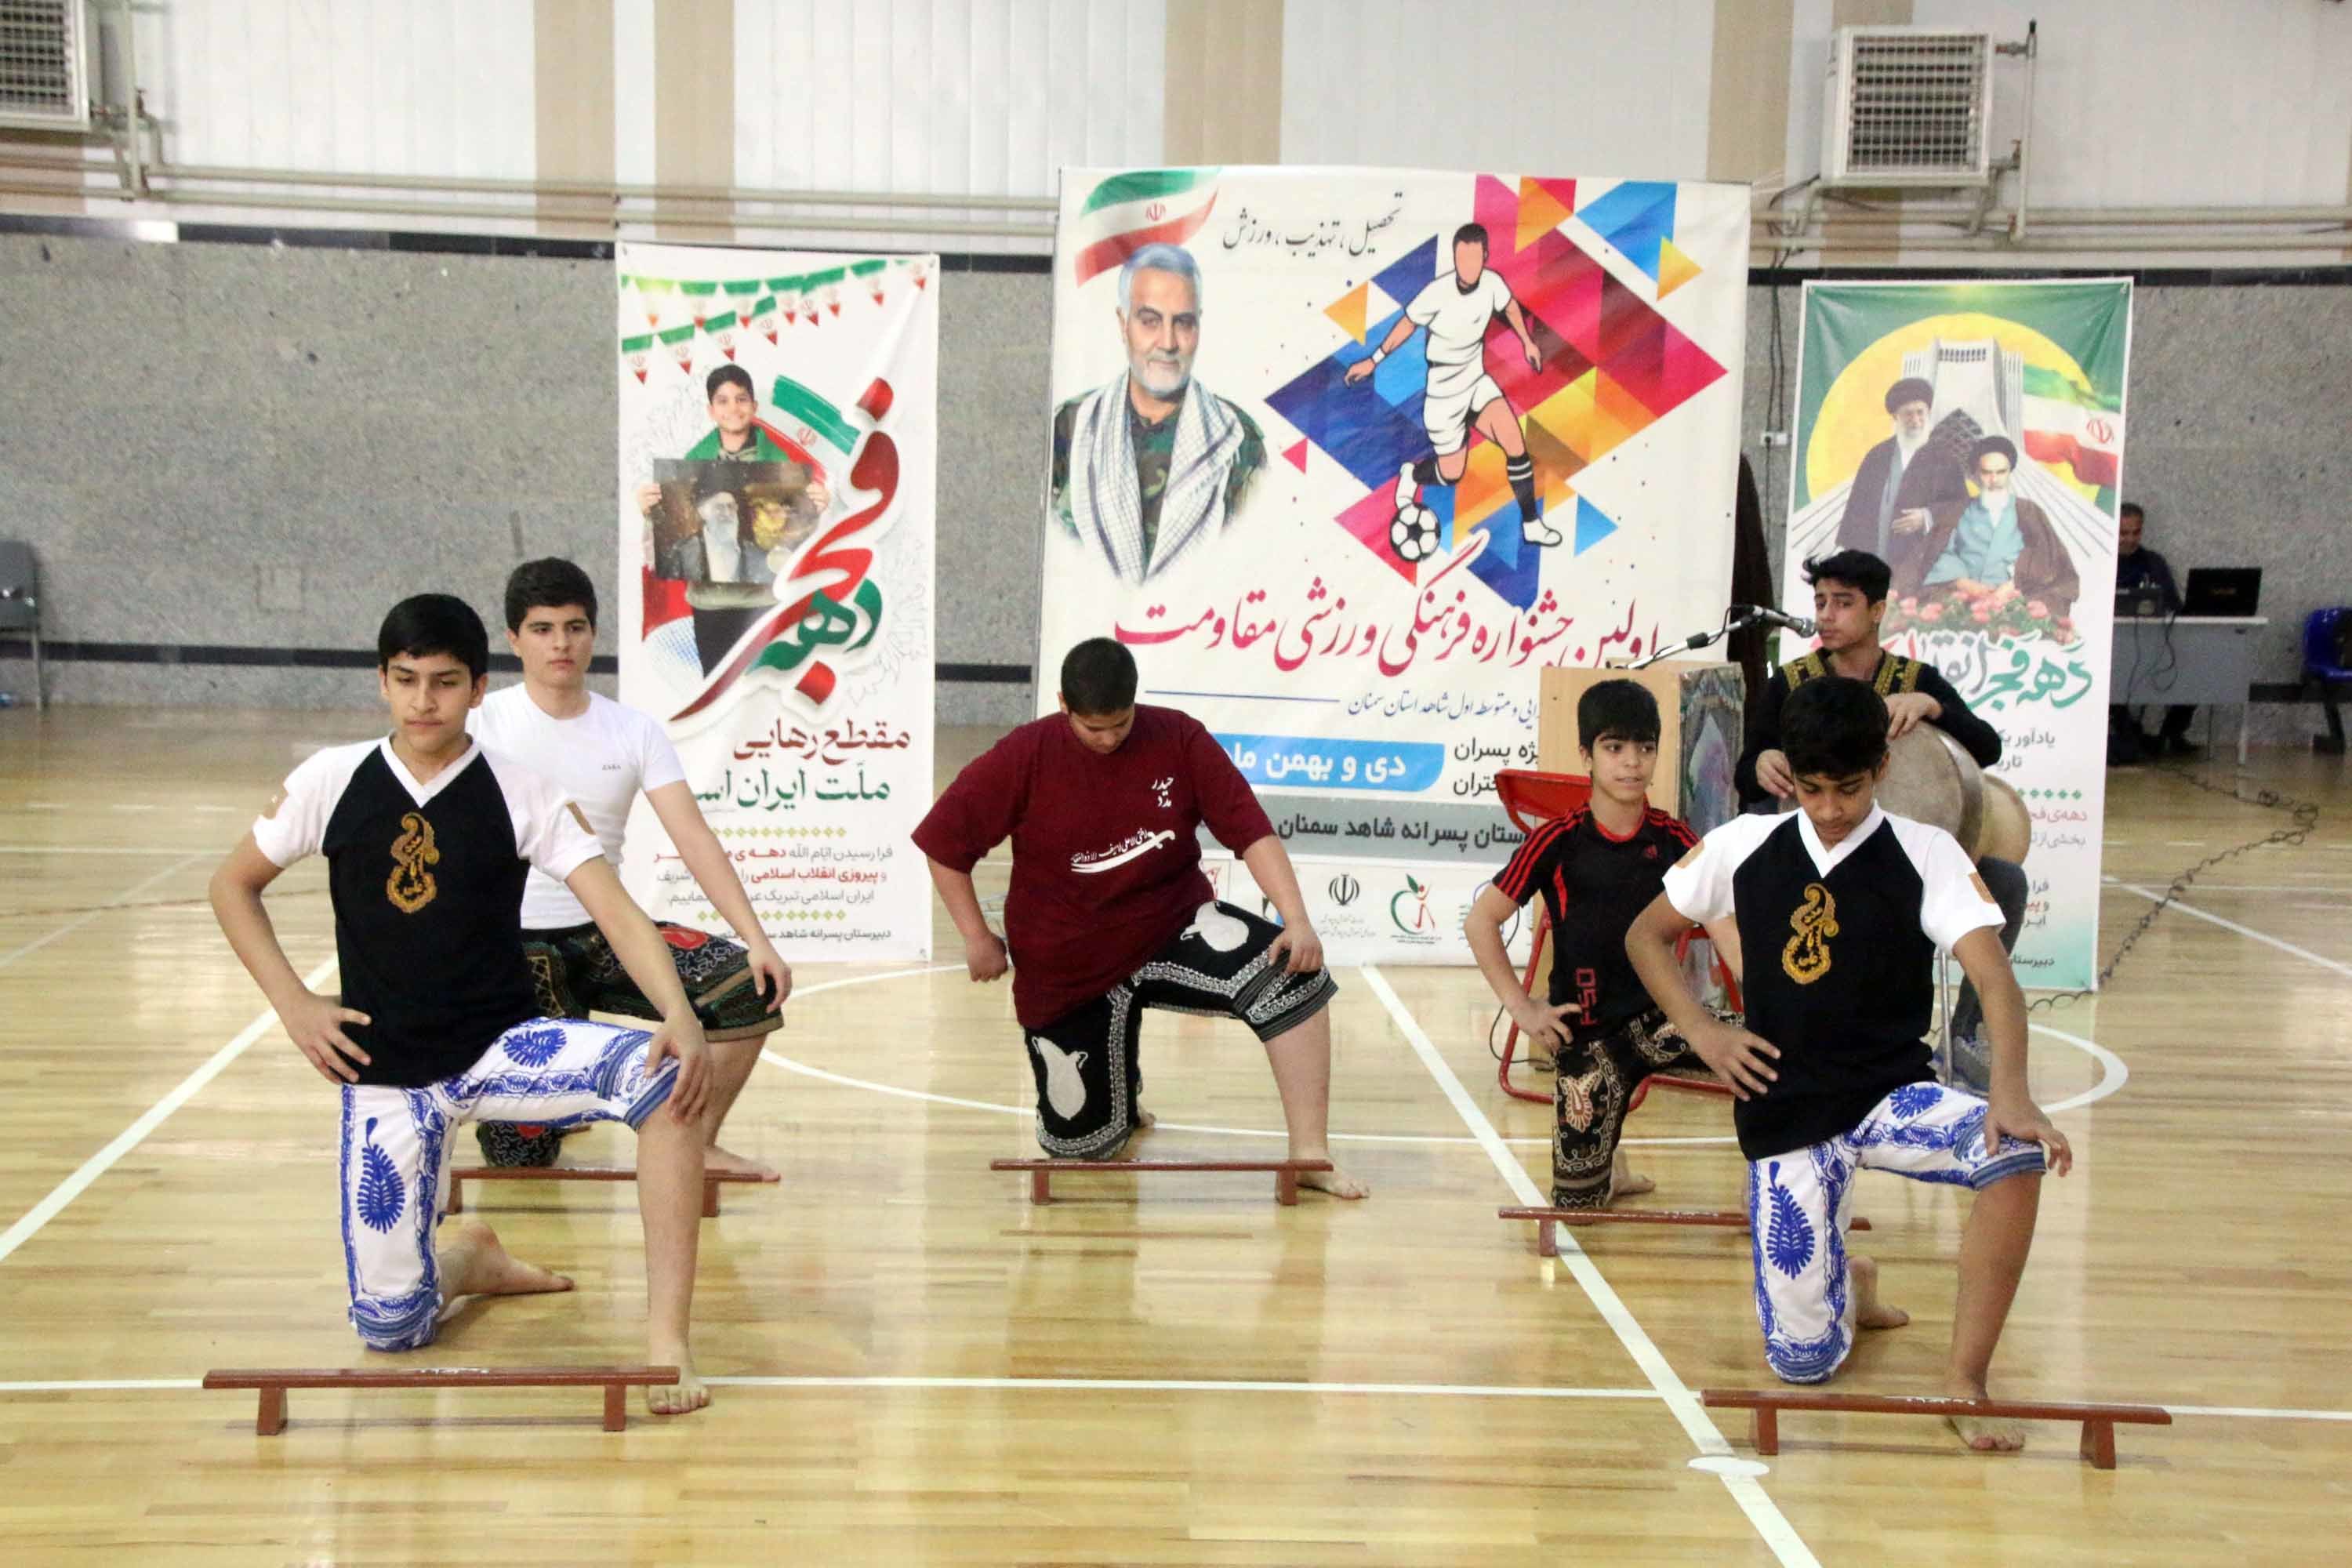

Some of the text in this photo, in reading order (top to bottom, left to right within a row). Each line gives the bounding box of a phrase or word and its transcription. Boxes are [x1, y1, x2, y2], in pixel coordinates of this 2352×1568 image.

[1223, 207, 1272, 249] ورزش
[1377, 536, 1485, 677] فرهنگی
[1114, 589, 1278, 651] مقاومت
[1274, 575, 1377, 671] ورزشی
[1472, 589, 1574, 668] جشنواره
[1348, 692, 1385, 715] سمنان
[1384, 690, 1418, 717] استان
[1418, 691, 1449, 714] شاهد
[1448, 691, 1474, 720] اول
[733, 716, 911, 766] مقطع رهایی
[1454, 737, 1511, 766] پسران
[1225, 741, 1406, 783] دی و بهمن ما
[736, 768, 806, 811] ایران
[1277, 813, 1338, 839] سمنان
[1345, 816, 1396, 839] شاهد
[1401, 821, 1468, 853] پسرانه
[751, 866, 796, 884] اسلامی
[798, 866, 836, 883] انقلاب
[839, 869, 879, 884] پیروزی
[801, 890, 844, 905] اسلامی
[847, 890, 875, 904] ایران
[779, 929, 808, 938] شاهد
[810, 929, 842, 942] پسرانه
[844, 929, 891, 941] دبیرستان
